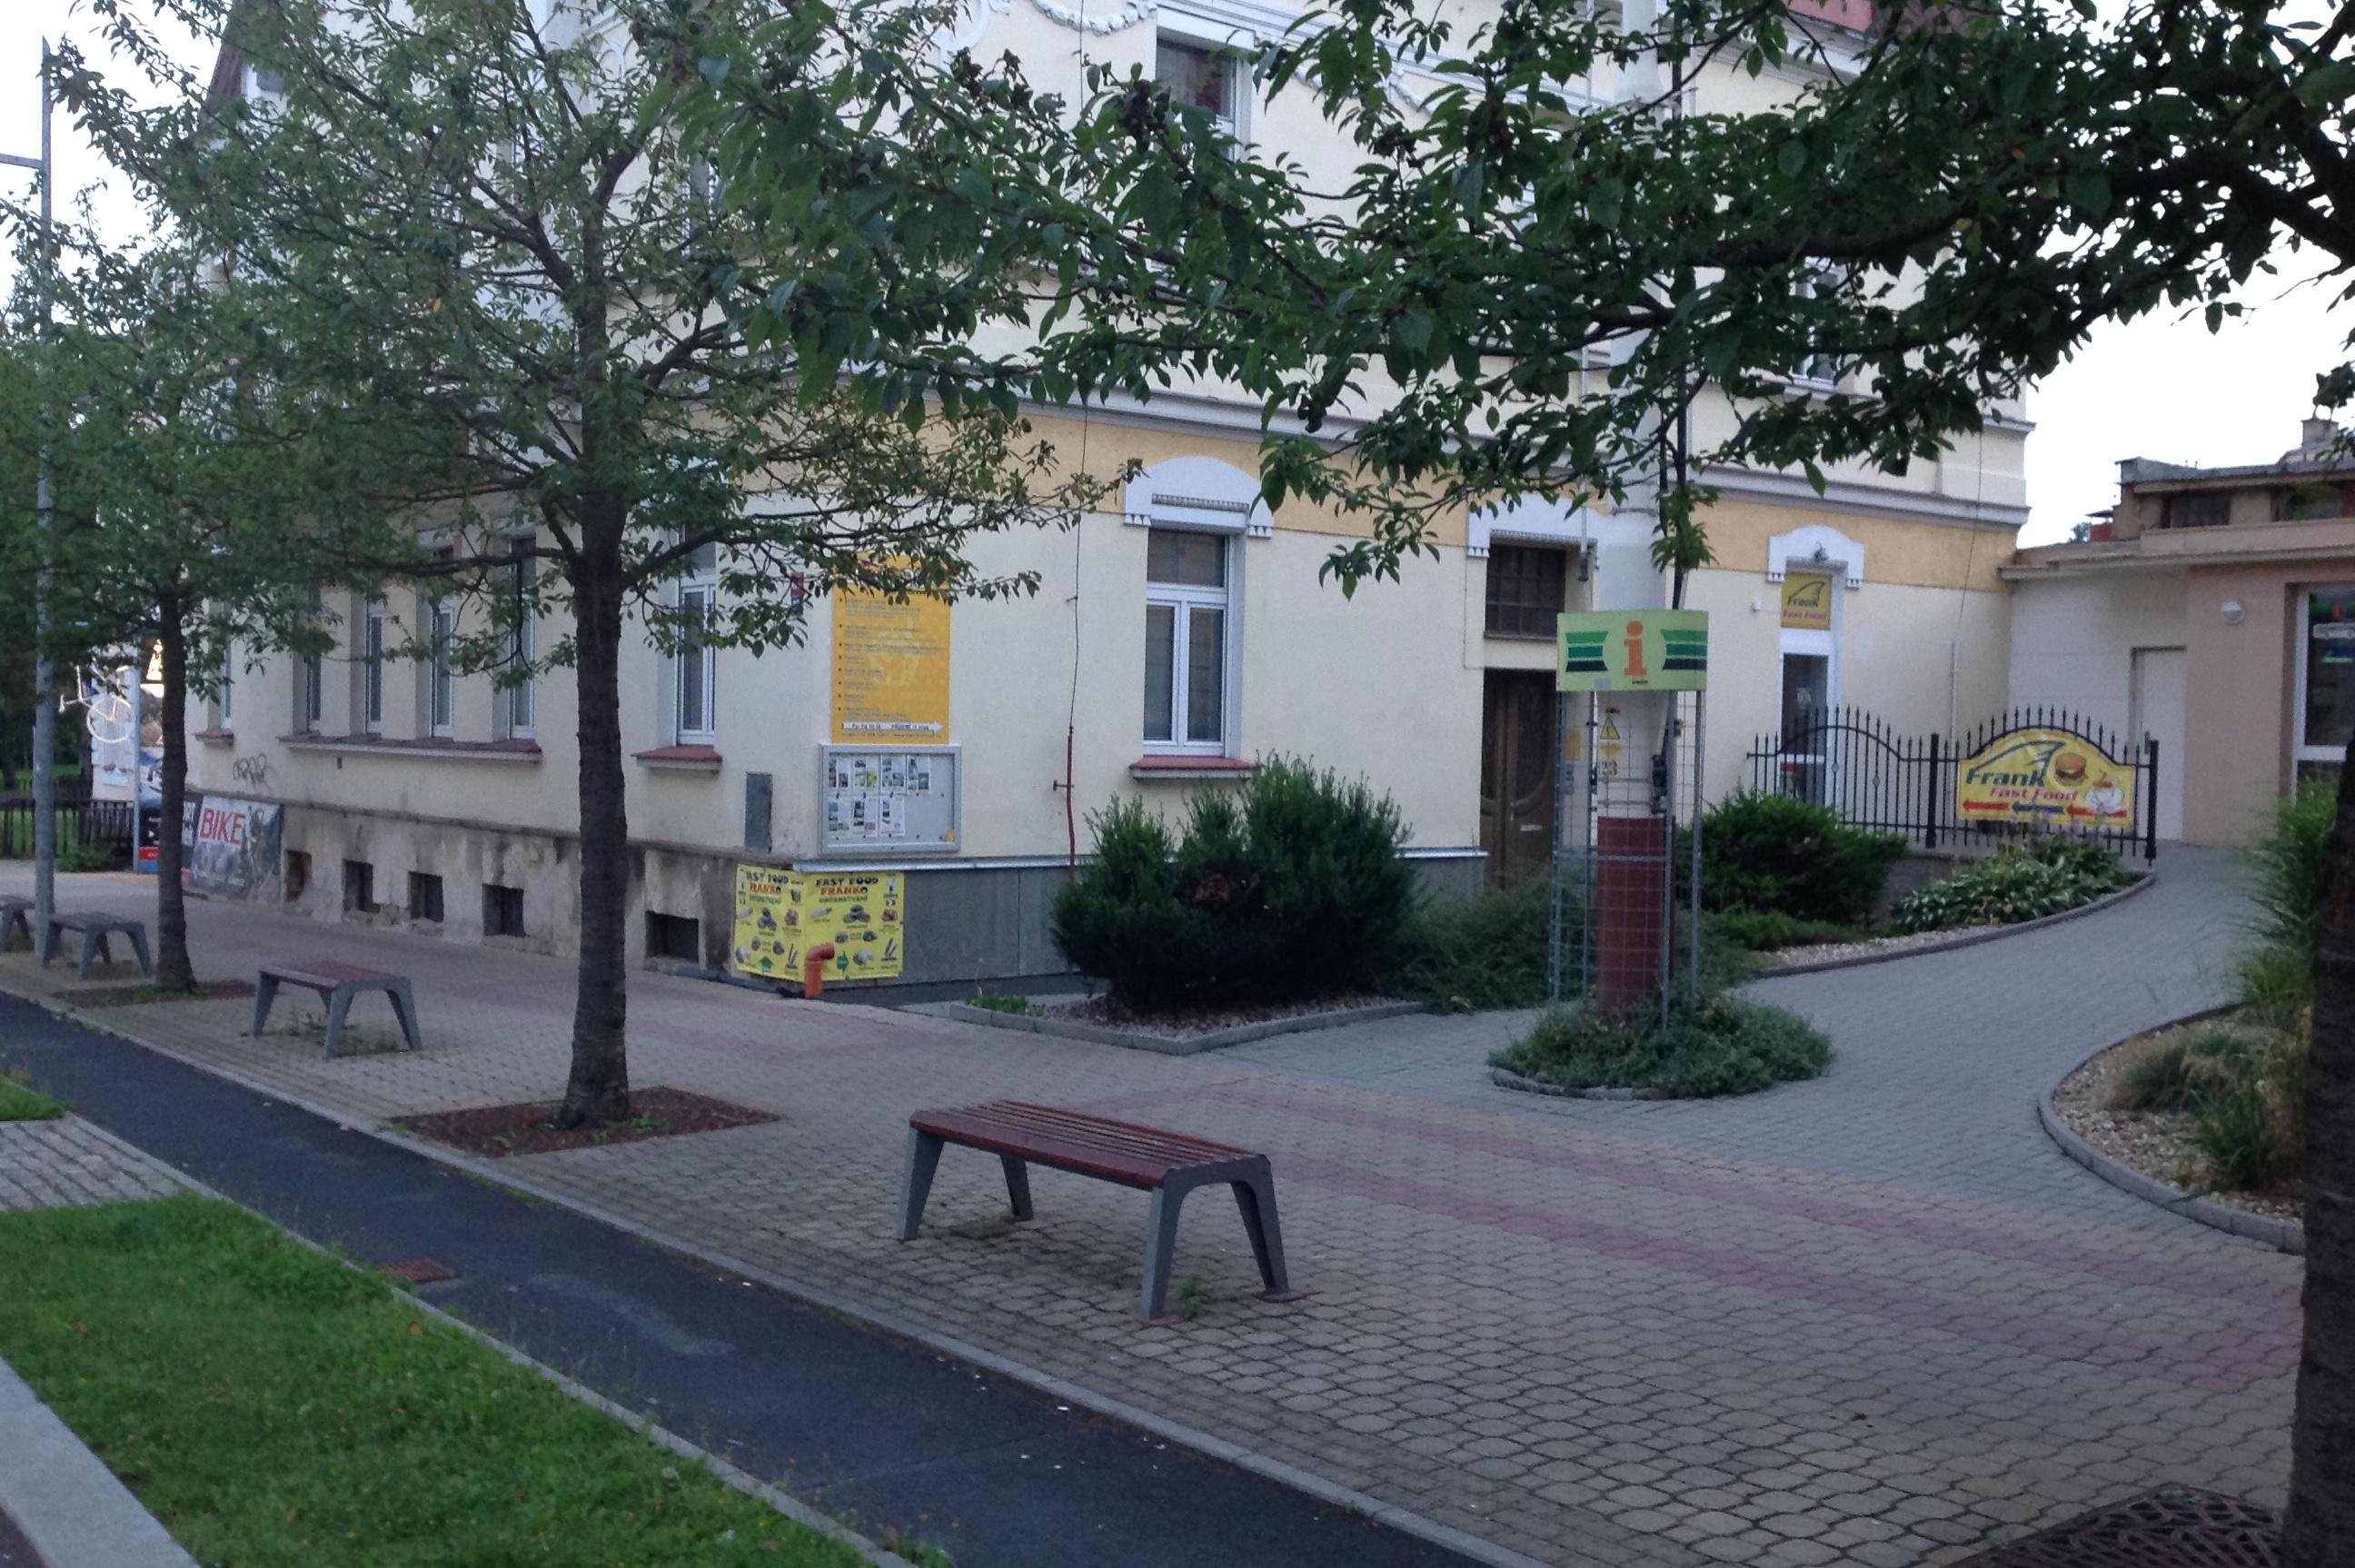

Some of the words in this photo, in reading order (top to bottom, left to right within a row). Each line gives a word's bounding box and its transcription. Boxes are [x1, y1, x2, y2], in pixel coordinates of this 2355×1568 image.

[1624, 620, 1647, 677] i
[1966, 769, 2044, 787] Frank
[199, 808, 247, 845] BIKE
[816, 878, 845, 887] FAST
[849, 876, 879, 886] FOOD
